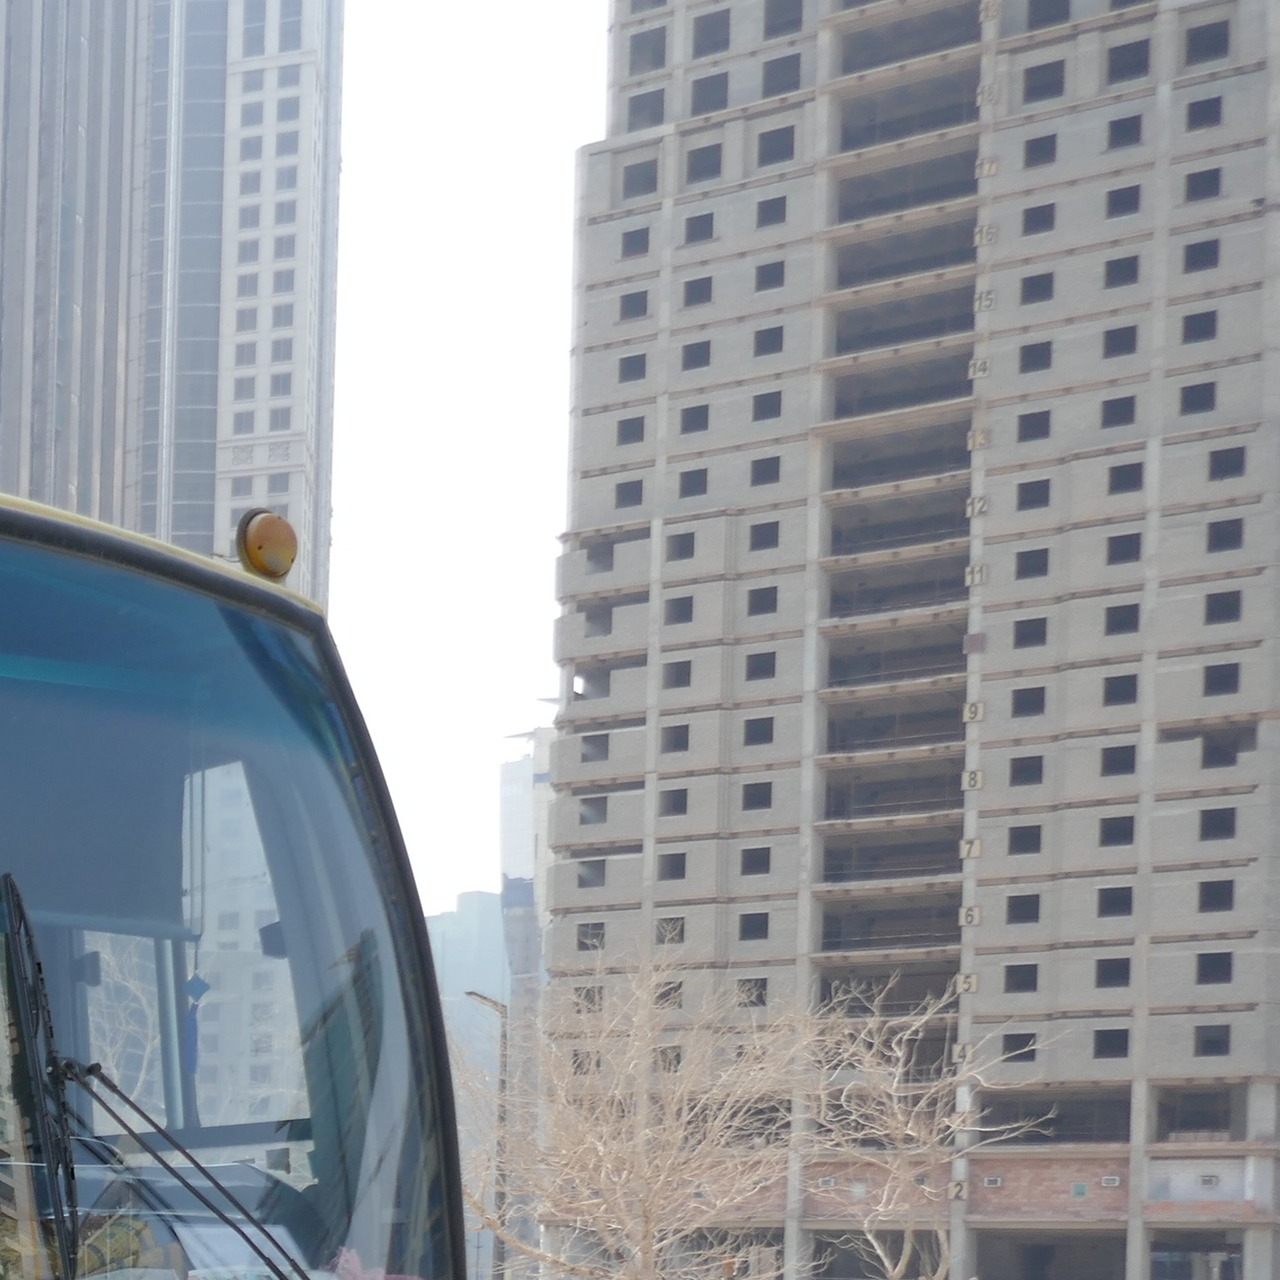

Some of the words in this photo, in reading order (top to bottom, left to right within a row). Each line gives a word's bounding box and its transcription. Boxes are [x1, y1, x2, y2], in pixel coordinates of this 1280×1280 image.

[975, 291, 994, 312] 15
[970, 360, 988, 376] 14
[967, 497, 987, 516] 12
[968, 703, 978, 720] 9
[968, 770, 977, 788] 8
[965, 840, 975, 858] 7
[965, 908, 974, 925] 6
[963, 975, 972, 992] 5
[954, 1182, 963, 1199] 2
